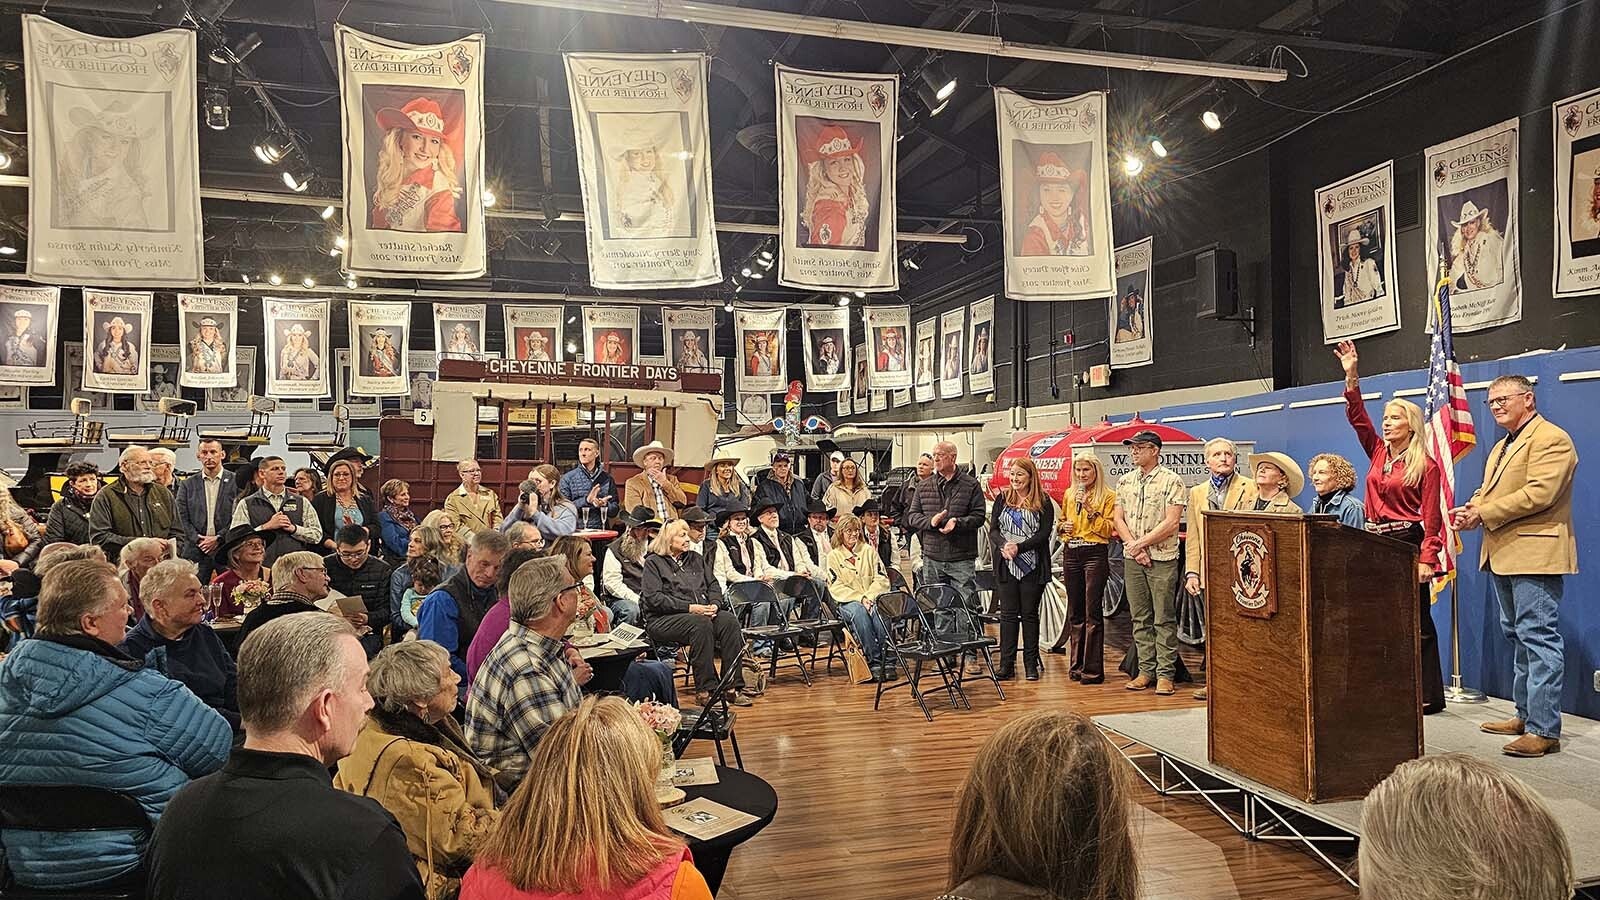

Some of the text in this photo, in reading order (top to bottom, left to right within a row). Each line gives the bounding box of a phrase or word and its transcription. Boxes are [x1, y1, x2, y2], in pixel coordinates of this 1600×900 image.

[1449, 144, 1509, 169] CHEYENNE
[1450, 164, 1486, 180] FRONTIER
[1336, 177, 1387, 202] CHEYENNE
[1339, 195, 1369, 211] FRONTIER
[489, 359, 677, 380] CHEYENNE FRONTIER DAYS
[420, 411, 427, 422] 5
